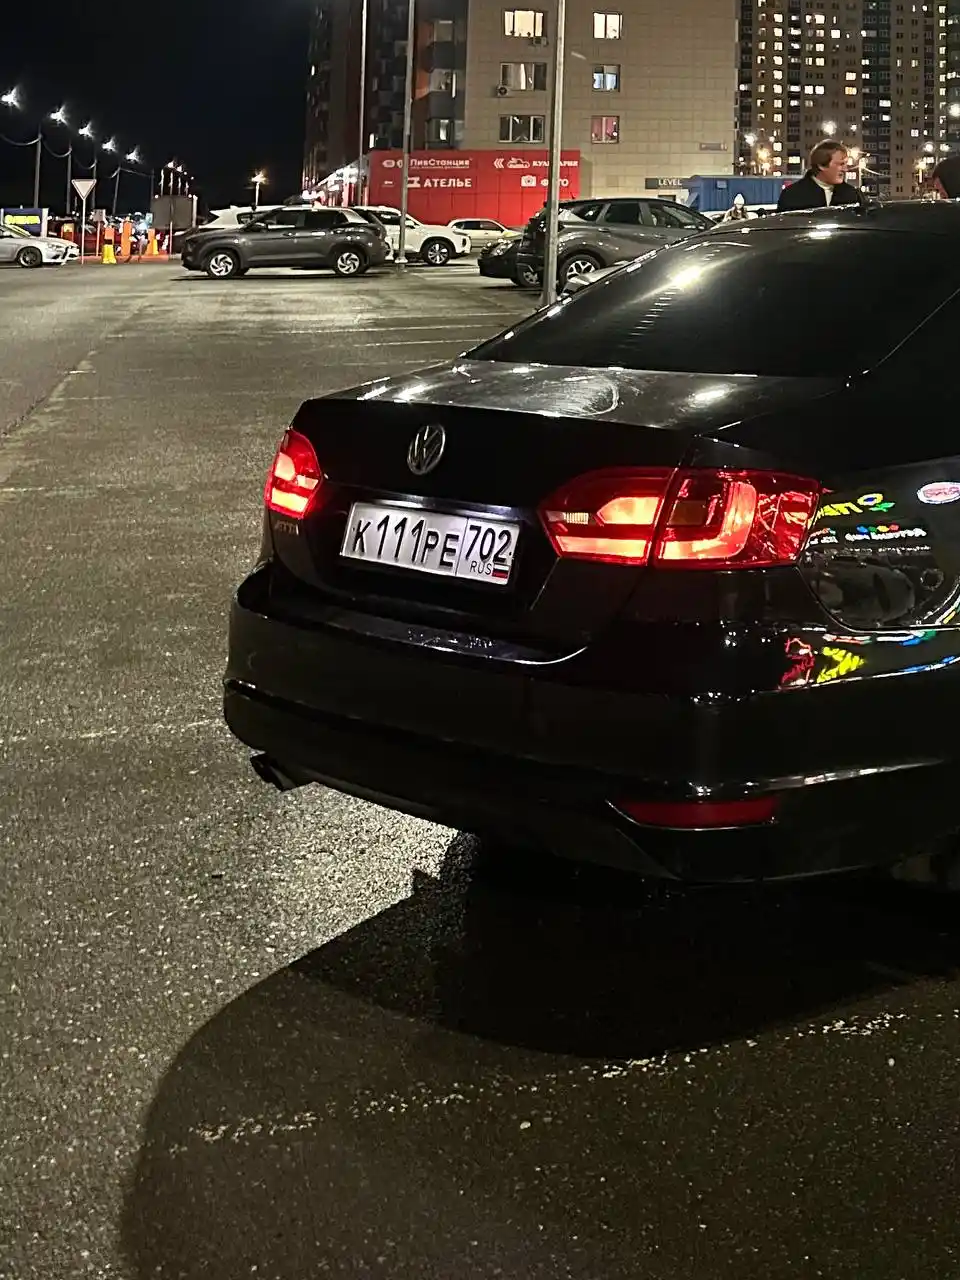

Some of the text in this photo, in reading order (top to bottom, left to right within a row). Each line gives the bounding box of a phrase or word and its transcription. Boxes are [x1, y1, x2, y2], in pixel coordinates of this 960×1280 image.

[423, 178, 472, 188] АТЕЛЬЕ
[466, 525, 511, 563] 702
[469, 560, 492, 576] RUS
